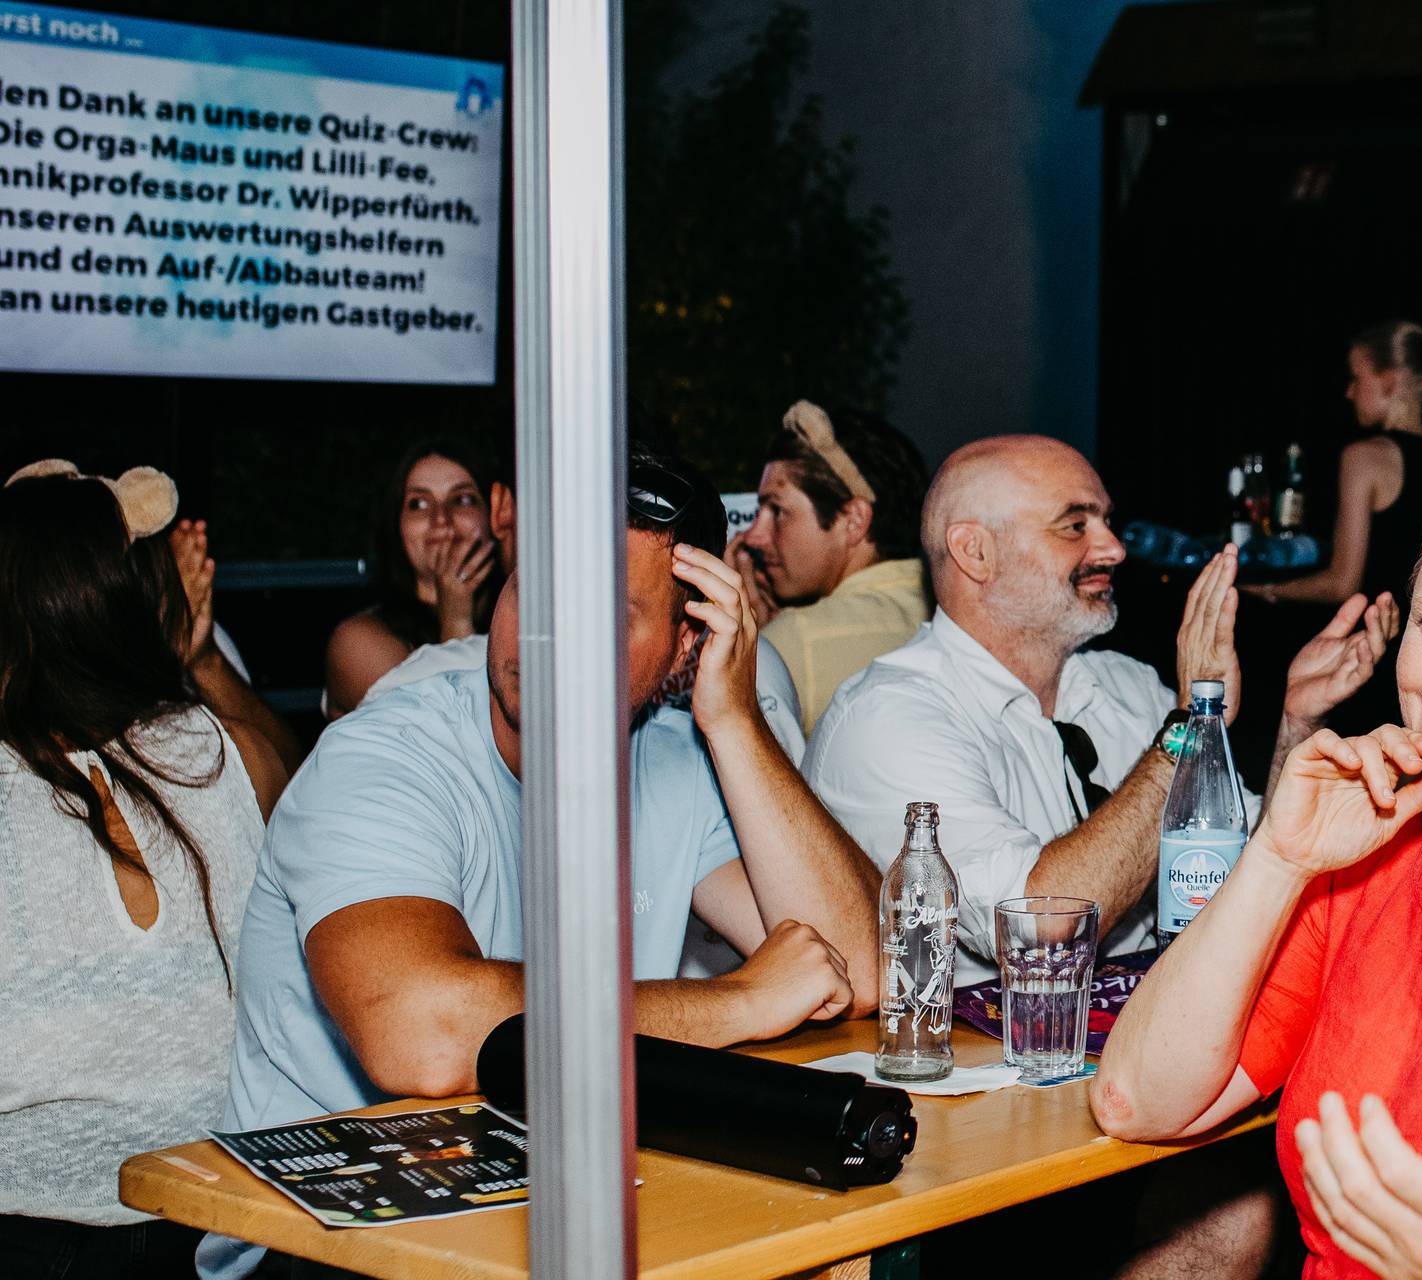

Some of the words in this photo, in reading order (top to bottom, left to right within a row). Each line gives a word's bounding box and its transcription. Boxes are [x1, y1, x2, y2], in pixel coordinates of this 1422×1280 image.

[49, 18, 118, 45] noch
[58, 83, 147, 120] Dank
[155, 100, 196, 125] an
[204, 102, 311, 136] unsere
[54, 126, 236, 166] Orga-Maus
[243, 147, 304, 172] und
[237, 180, 281, 210] Dr.
[124, 211, 445, 257] Auswertungshelfern
[0, 244, 62, 272] und
[71, 247, 147, 277] dem
[156, 252, 425, 293] Auf-/Abbauteam!
[0, 288, 42, 312] an
[51, 290, 168, 318] unsere
[176, 290, 319, 329] heutigen
[327, 301, 483, 335] Gastgeber.
[1168, 869, 1226, 884] Rheinfel
[1186, 884, 1211, 892] Quelle
